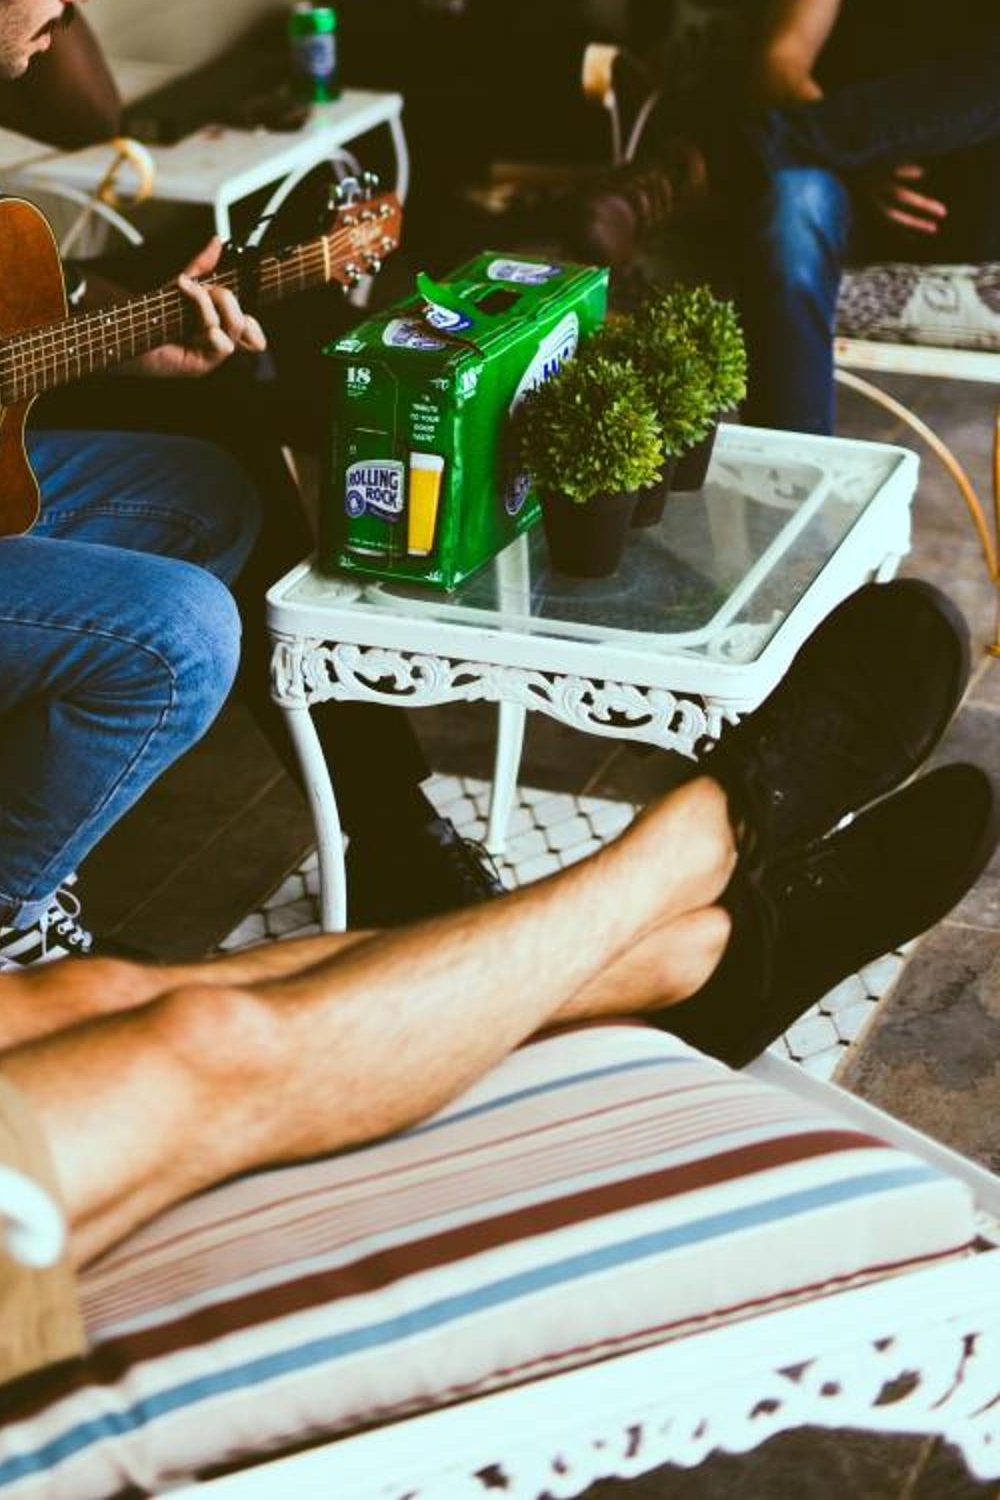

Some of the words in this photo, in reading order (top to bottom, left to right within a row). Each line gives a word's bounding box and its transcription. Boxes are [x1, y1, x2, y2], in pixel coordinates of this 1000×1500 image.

[346, 367, 372, 385] 18
[349, 469, 399, 490] ROLLING
[366, 488, 398, 509] ROCK
